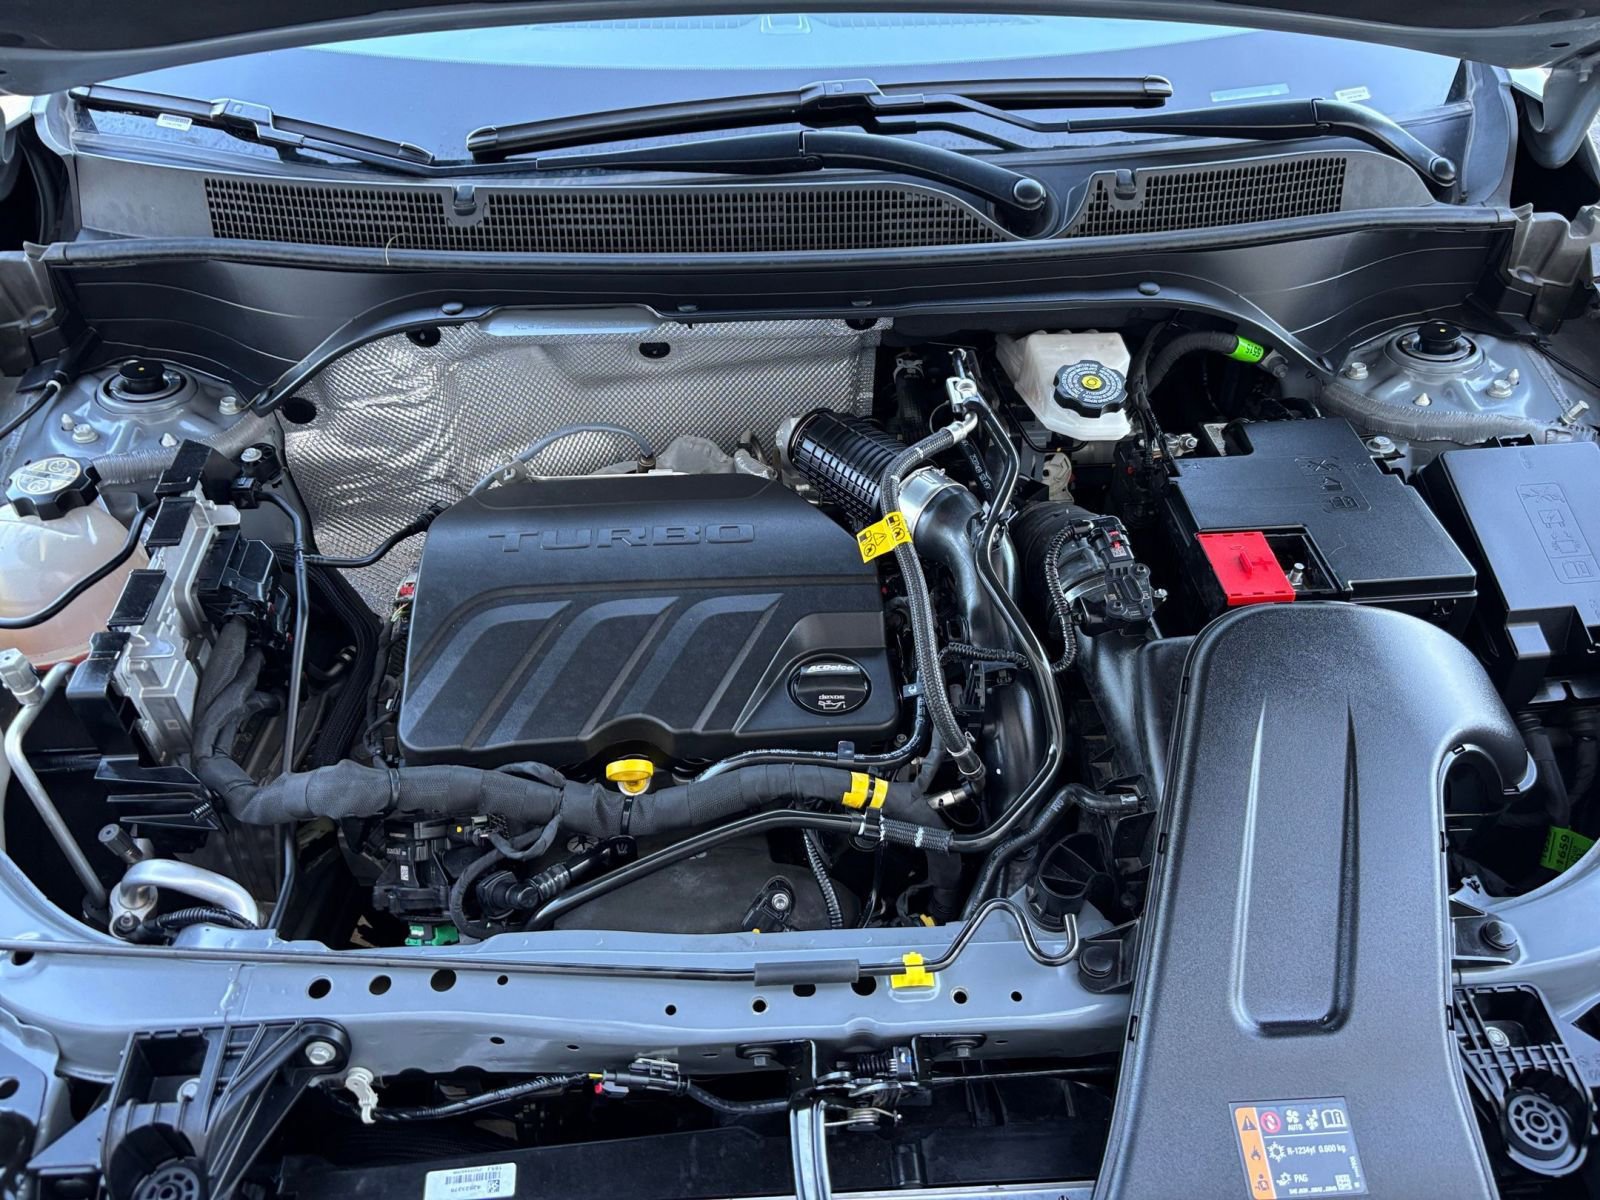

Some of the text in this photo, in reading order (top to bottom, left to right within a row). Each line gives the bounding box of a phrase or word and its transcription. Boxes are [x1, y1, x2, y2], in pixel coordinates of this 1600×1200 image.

[487, 523, 756, 553] TURBO
[806, 664, 855, 674] ACDelco
[1287, 1123, 1303, 1131] AUTO
[1287, 1144, 1317, 1156] R-1234yf
[1336, 1143, 1347, 1153] kg
[1293, 1173, 1309, 1184] PAG
